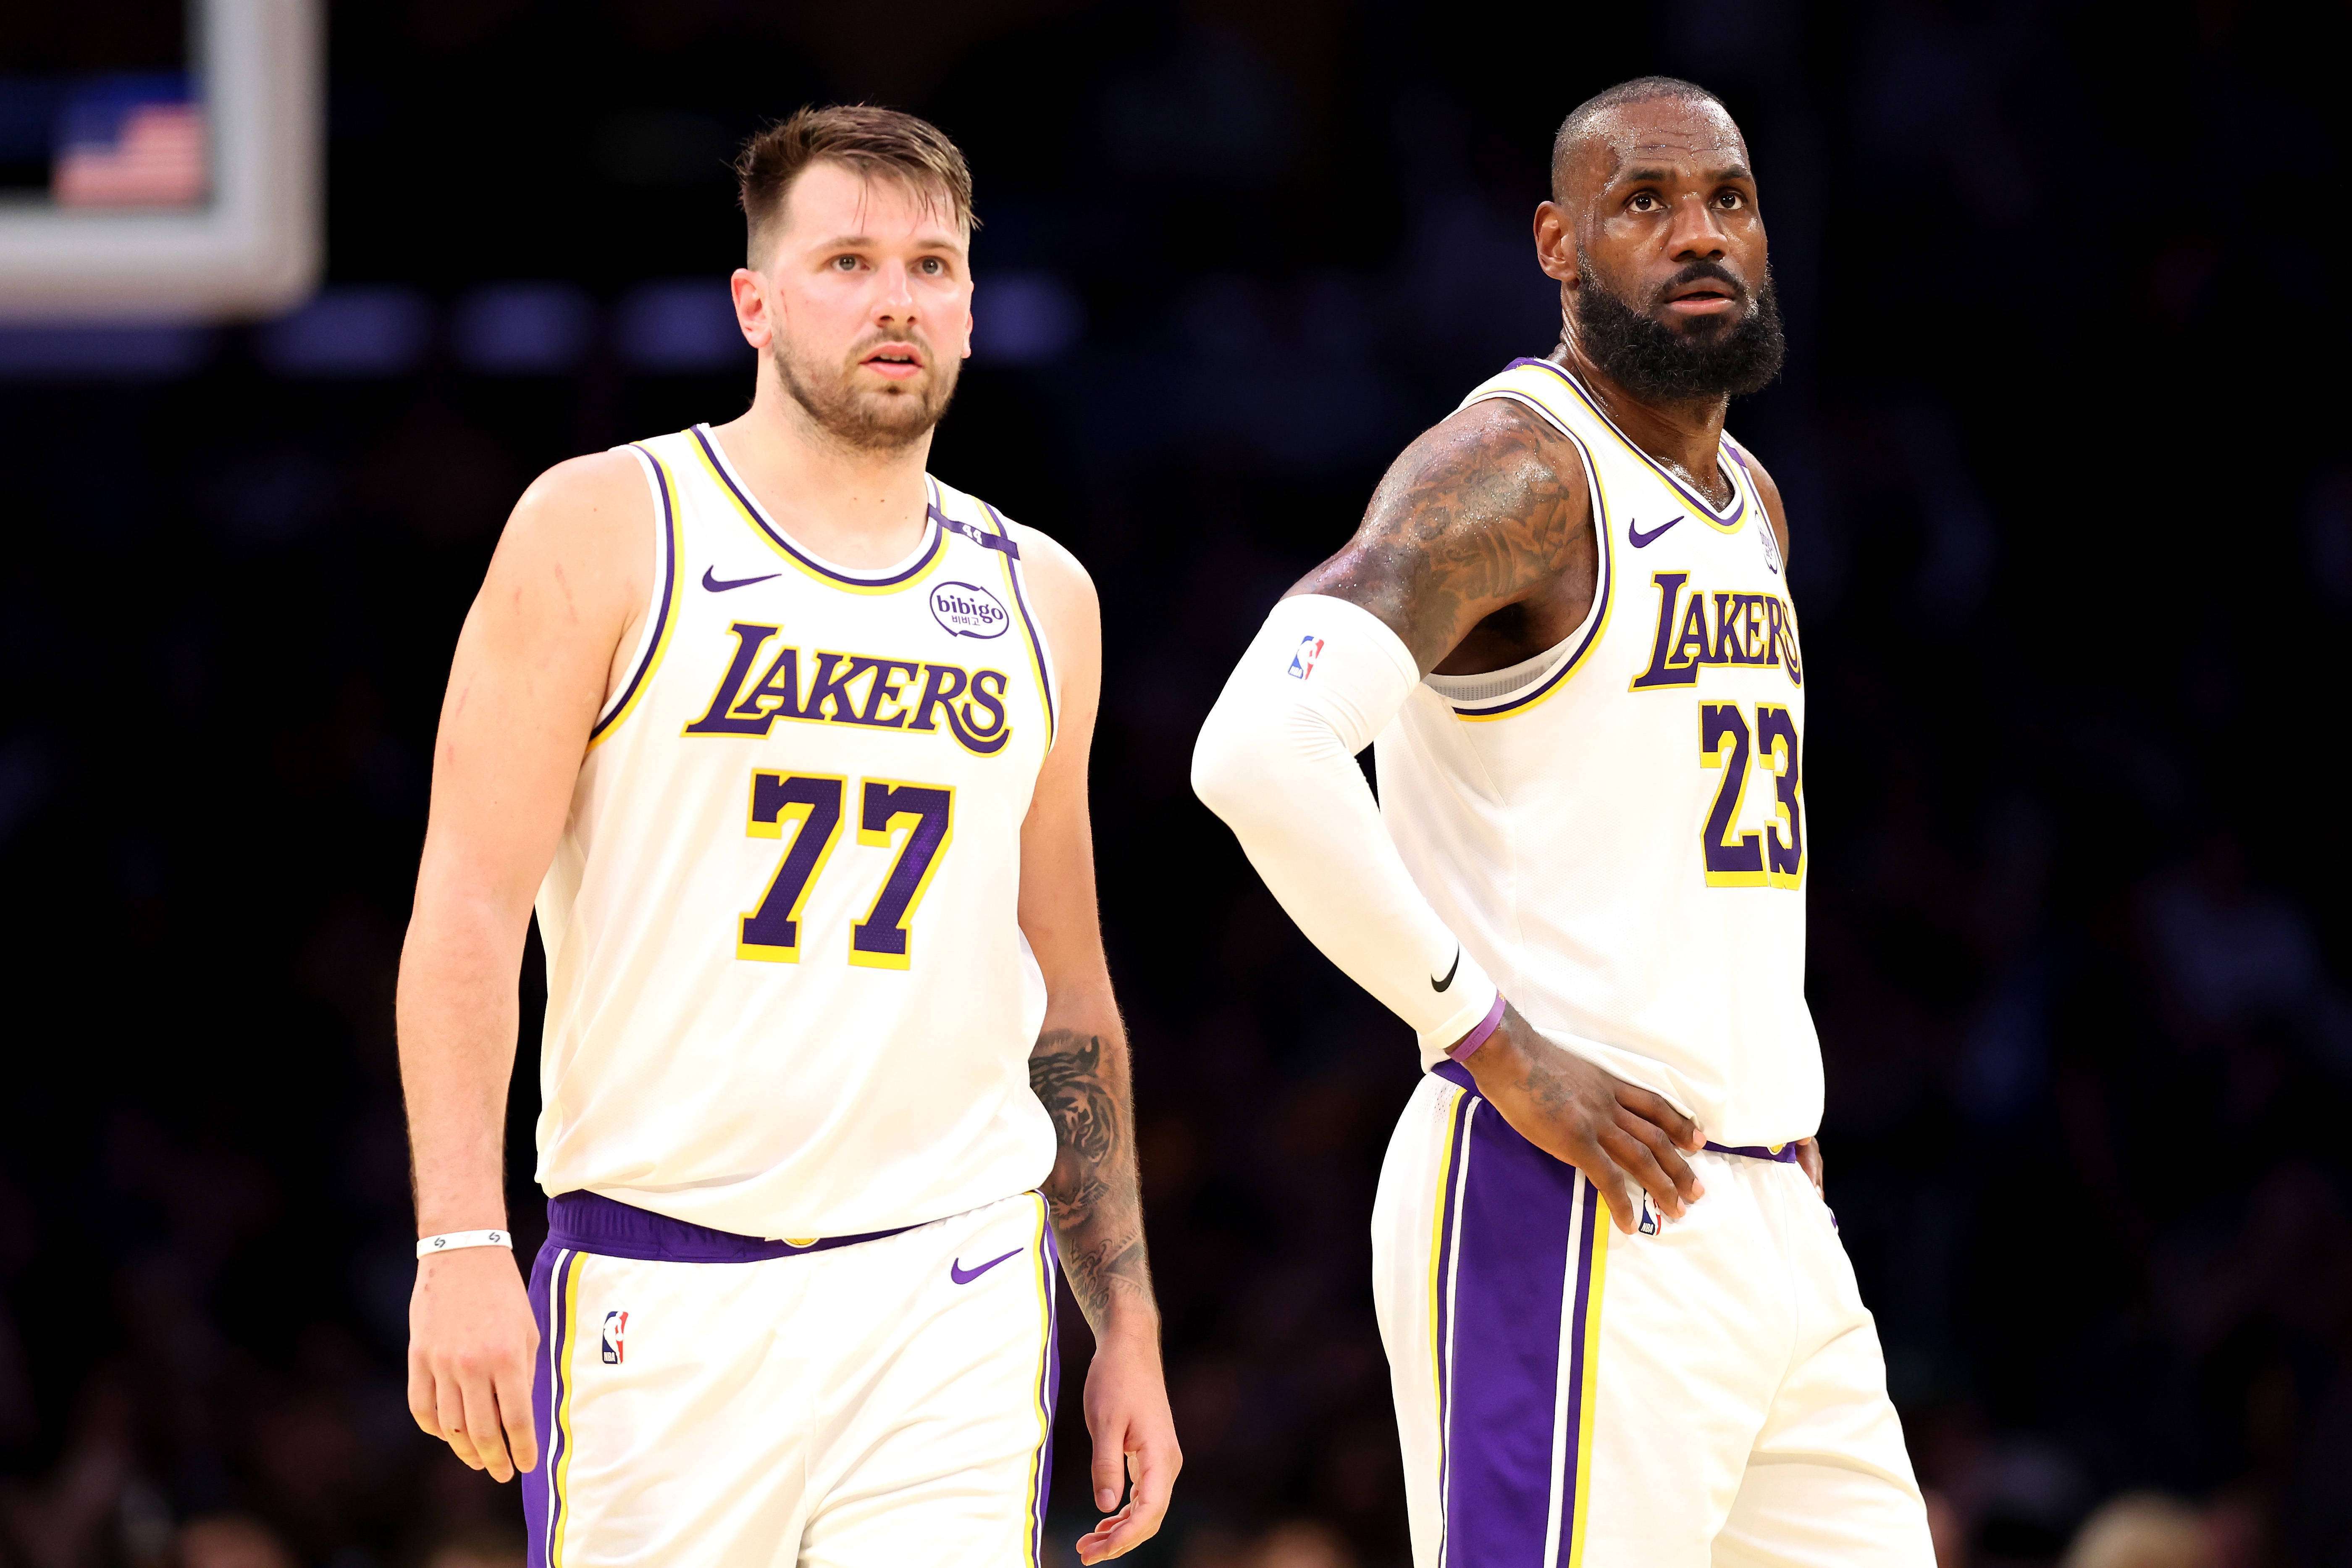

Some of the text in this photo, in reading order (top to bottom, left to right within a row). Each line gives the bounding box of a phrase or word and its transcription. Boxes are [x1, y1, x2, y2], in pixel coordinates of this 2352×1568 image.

[962, 525, 982, 544] 44
[937, 595, 1003, 623] bibigo
[952, 615, 980, 626] 비비고
[1628, 570, 1802, 693] LAKERS
[679, 619, 1014, 759] LAKERS
[1698, 699, 1805, 891] 23
[735, 767, 957, 971] 77
[1641, 1222, 1654, 1233] NBA
[604, 1351, 616, 1362] NBA
